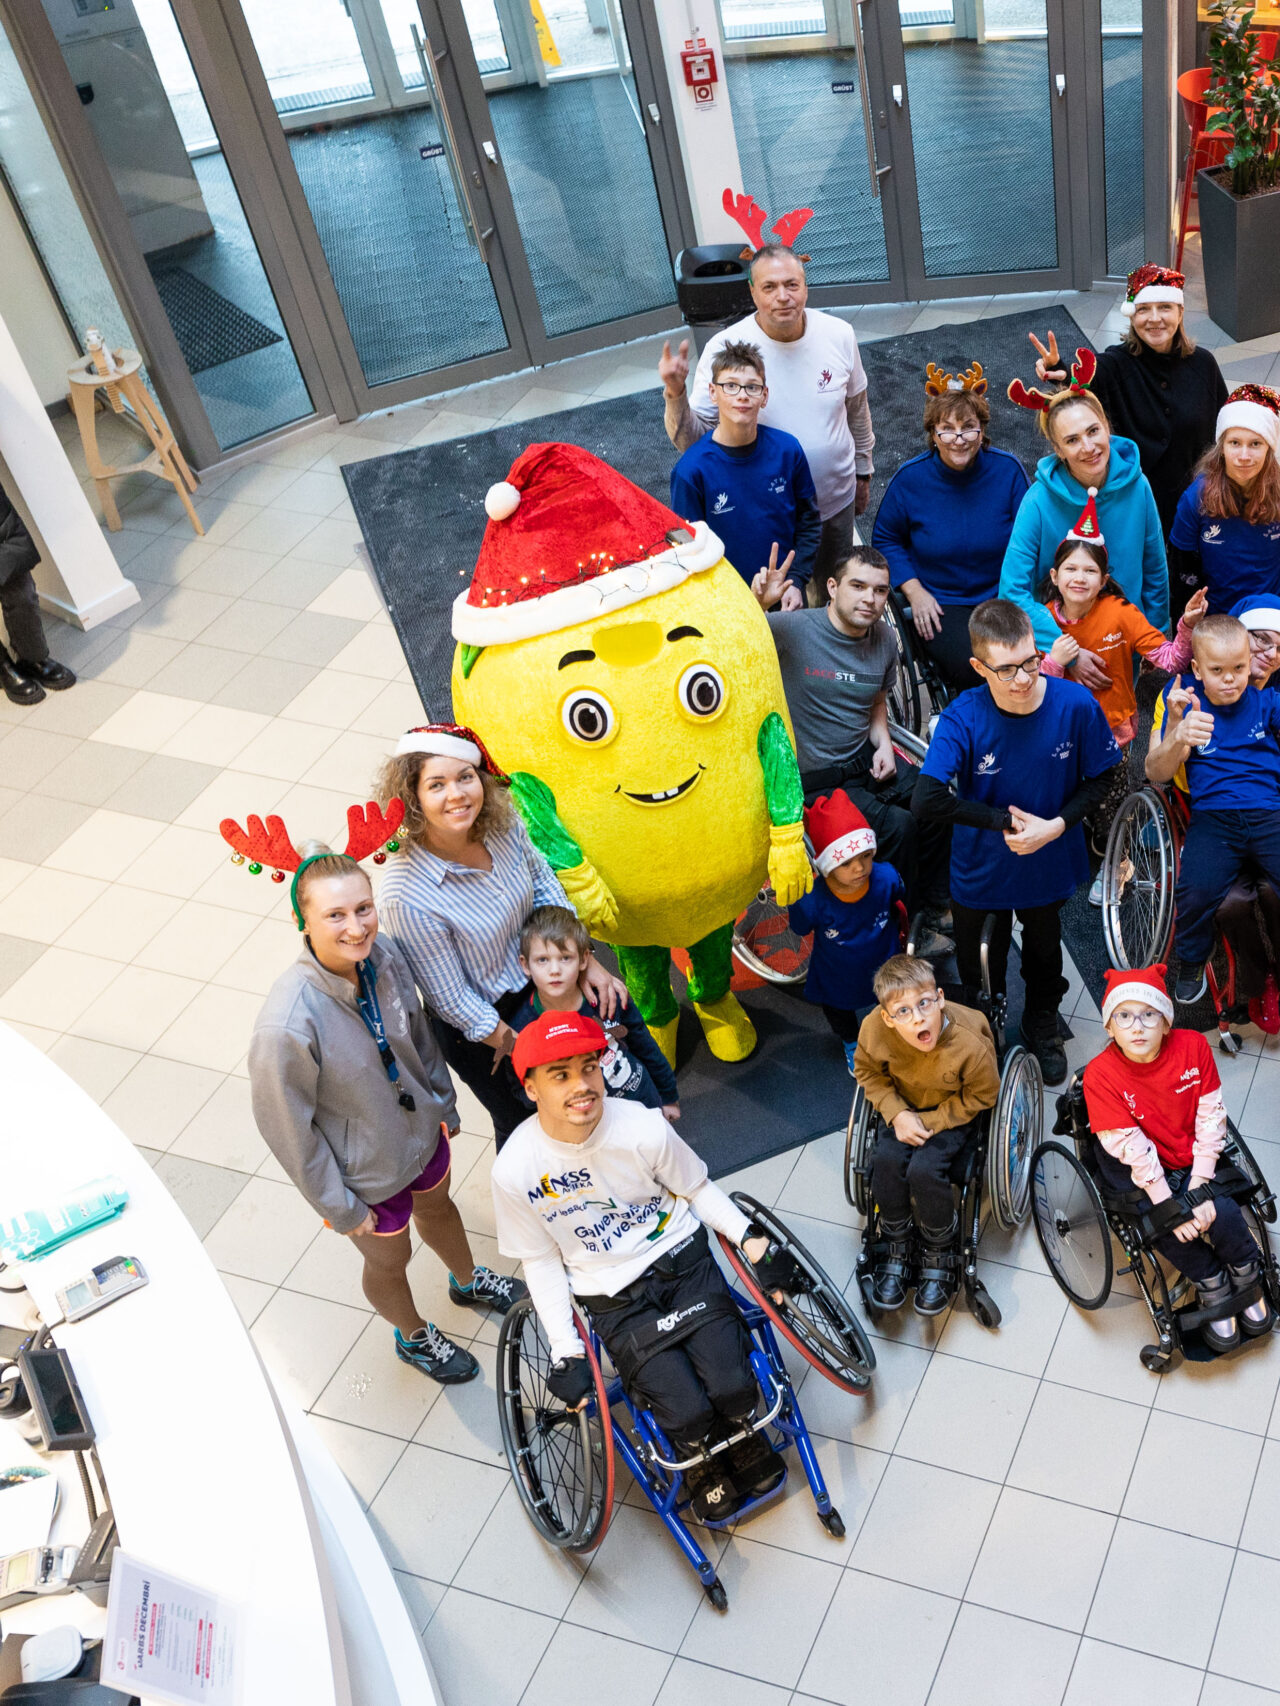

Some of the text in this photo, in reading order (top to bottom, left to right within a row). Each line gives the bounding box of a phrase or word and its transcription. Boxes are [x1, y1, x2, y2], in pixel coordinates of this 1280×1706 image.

[804, 667, 856, 682] LACOSTE
[528, 1168, 591, 1204] MĒNESS
[602, 1235, 613, 1252] ir
[656, 1301, 707, 1332] RGK PRO
